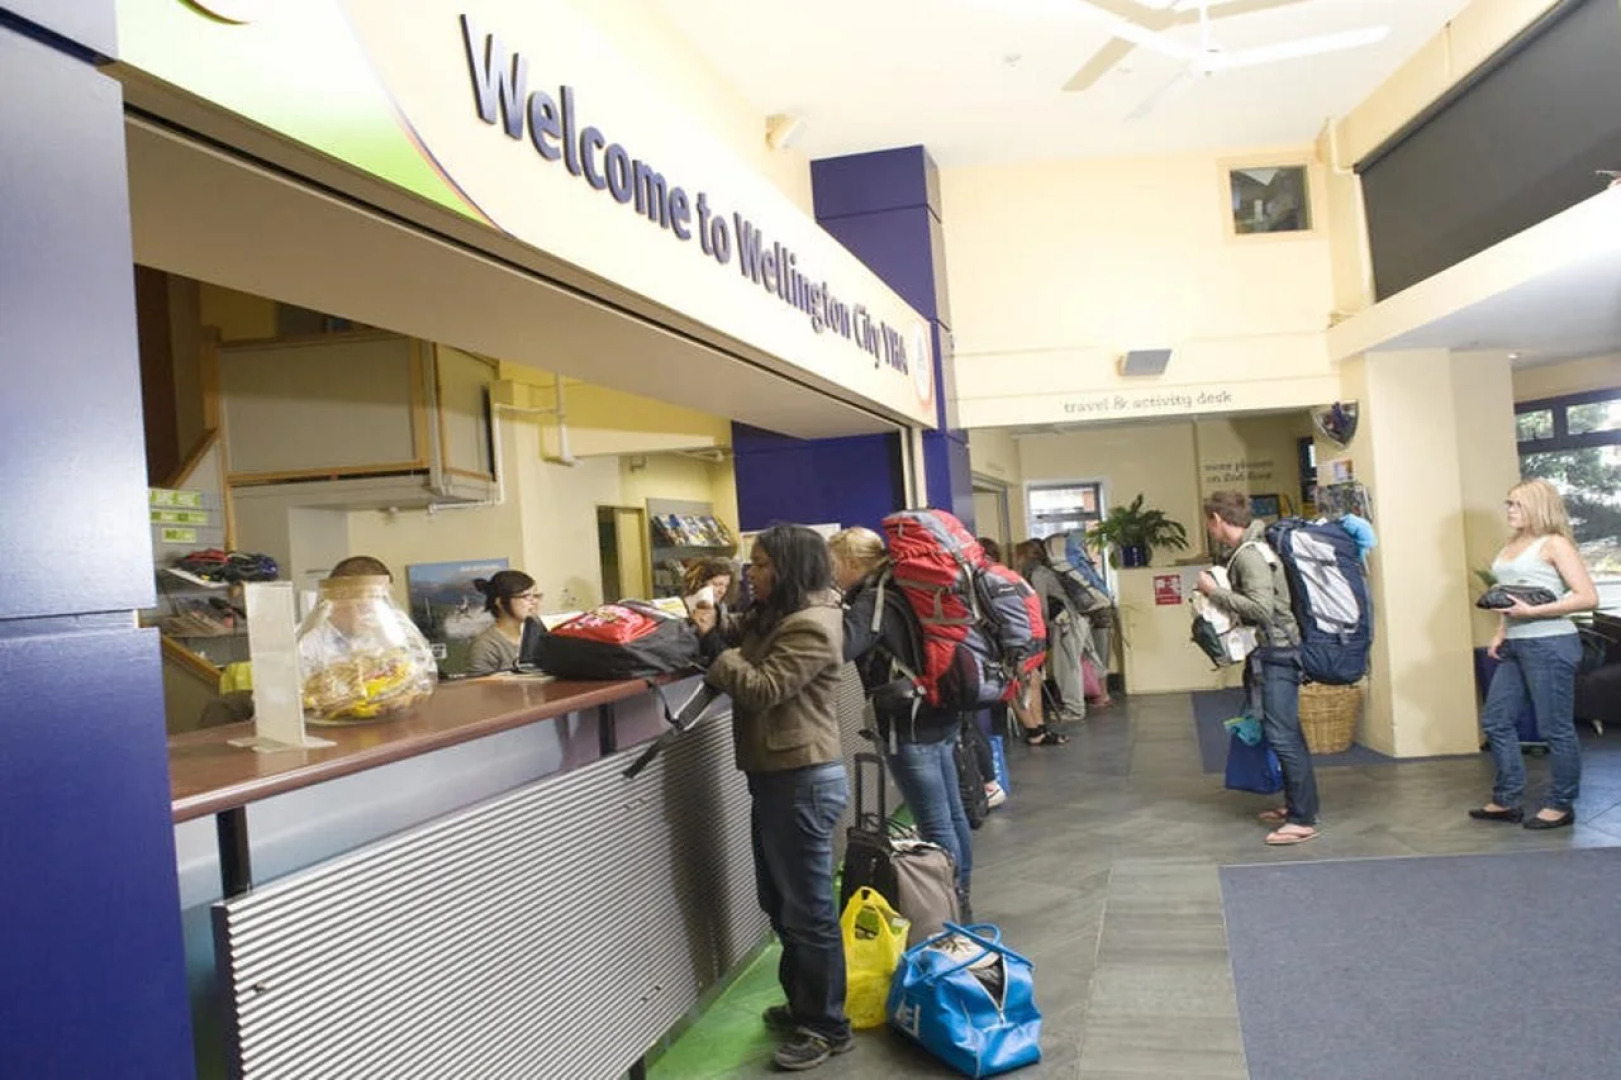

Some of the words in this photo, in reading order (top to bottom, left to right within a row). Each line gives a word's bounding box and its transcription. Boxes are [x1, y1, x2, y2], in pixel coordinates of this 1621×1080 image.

[459, 13, 692, 240] Welcome
[696, 192, 731, 264] to
[733, 211, 851, 339] Wellington
[853, 303, 881, 369] City
[881, 320, 909, 376] YHA
[1063, 396, 1109, 414] travel
[1113, 395, 1127, 411] &
[1132, 394, 1192, 409] activity
[1197, 390, 1232, 405] desk
